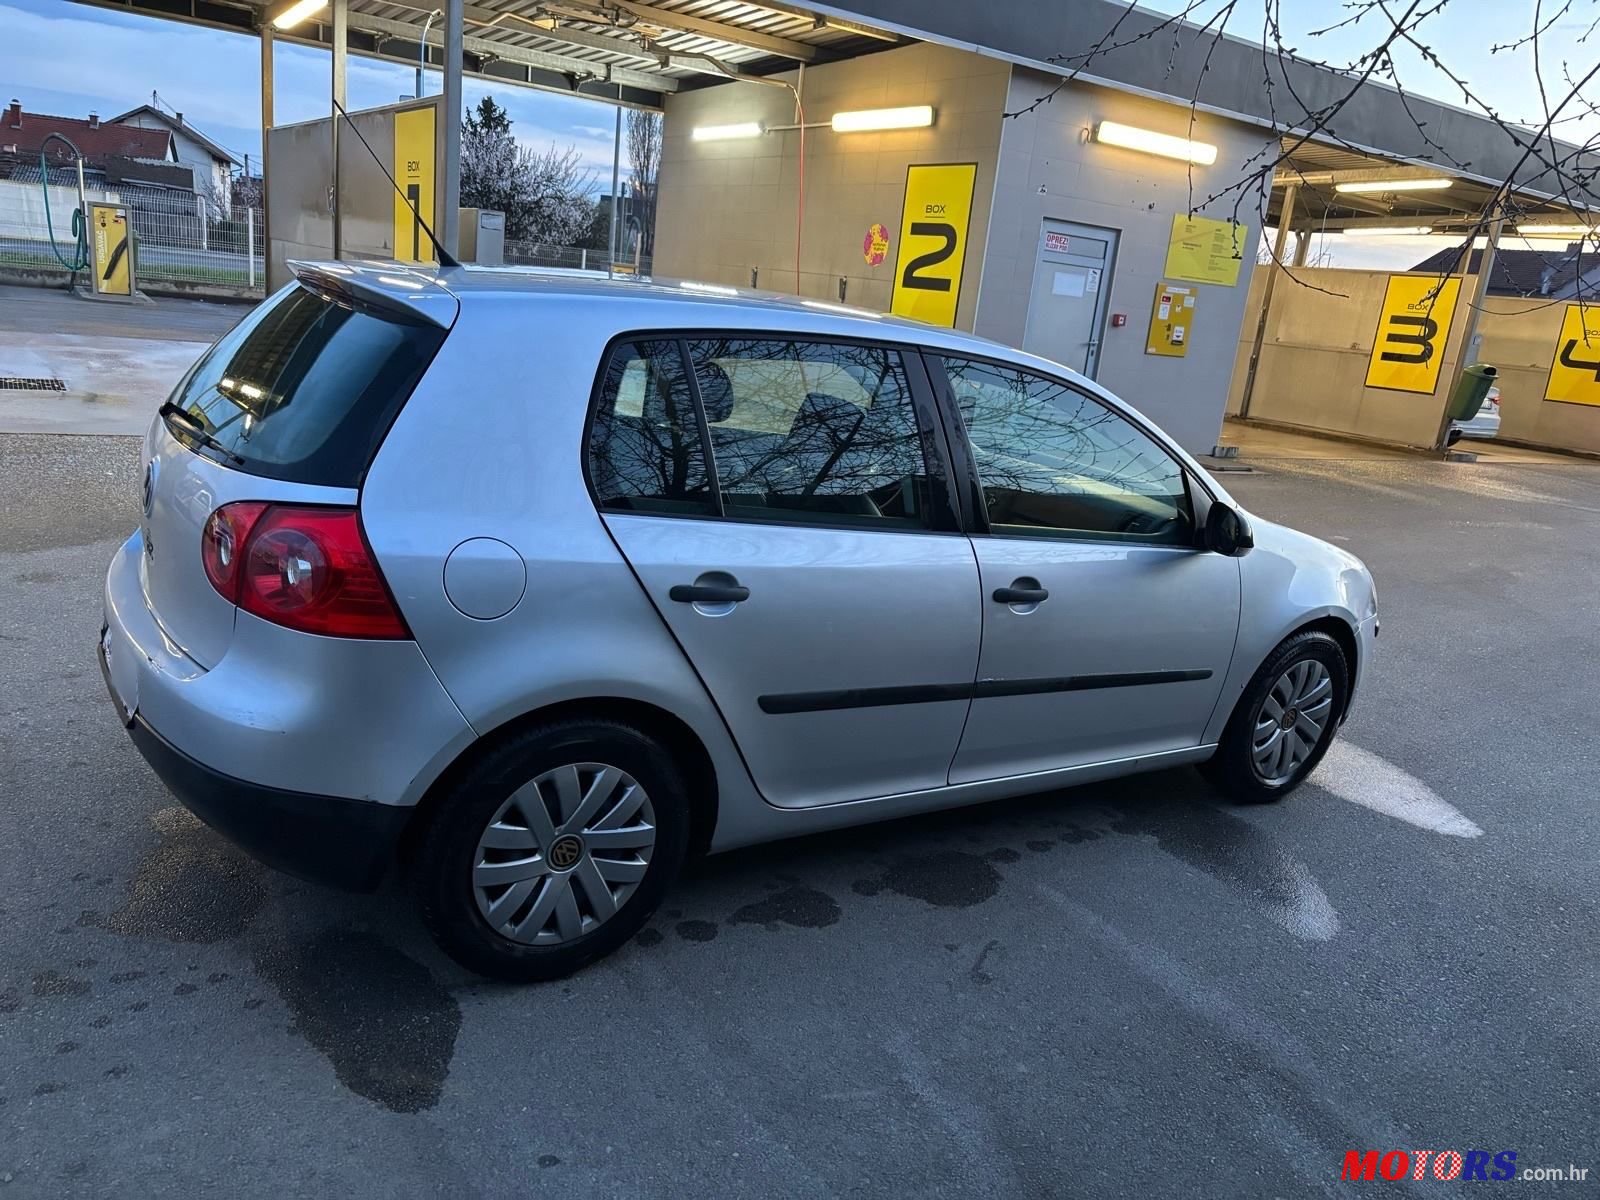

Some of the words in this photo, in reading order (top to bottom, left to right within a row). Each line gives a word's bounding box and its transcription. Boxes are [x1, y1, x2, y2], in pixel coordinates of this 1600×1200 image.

[407, 161, 420, 172] BOX
[925, 204, 946, 214] BOX
[408, 184, 420, 262] 1
[1046, 234, 1069, 246] OPREZ!
[902, 222, 957, 292] 2
[1407, 303, 1430, 311] BOX
[1381, 315, 1438, 364] 3
